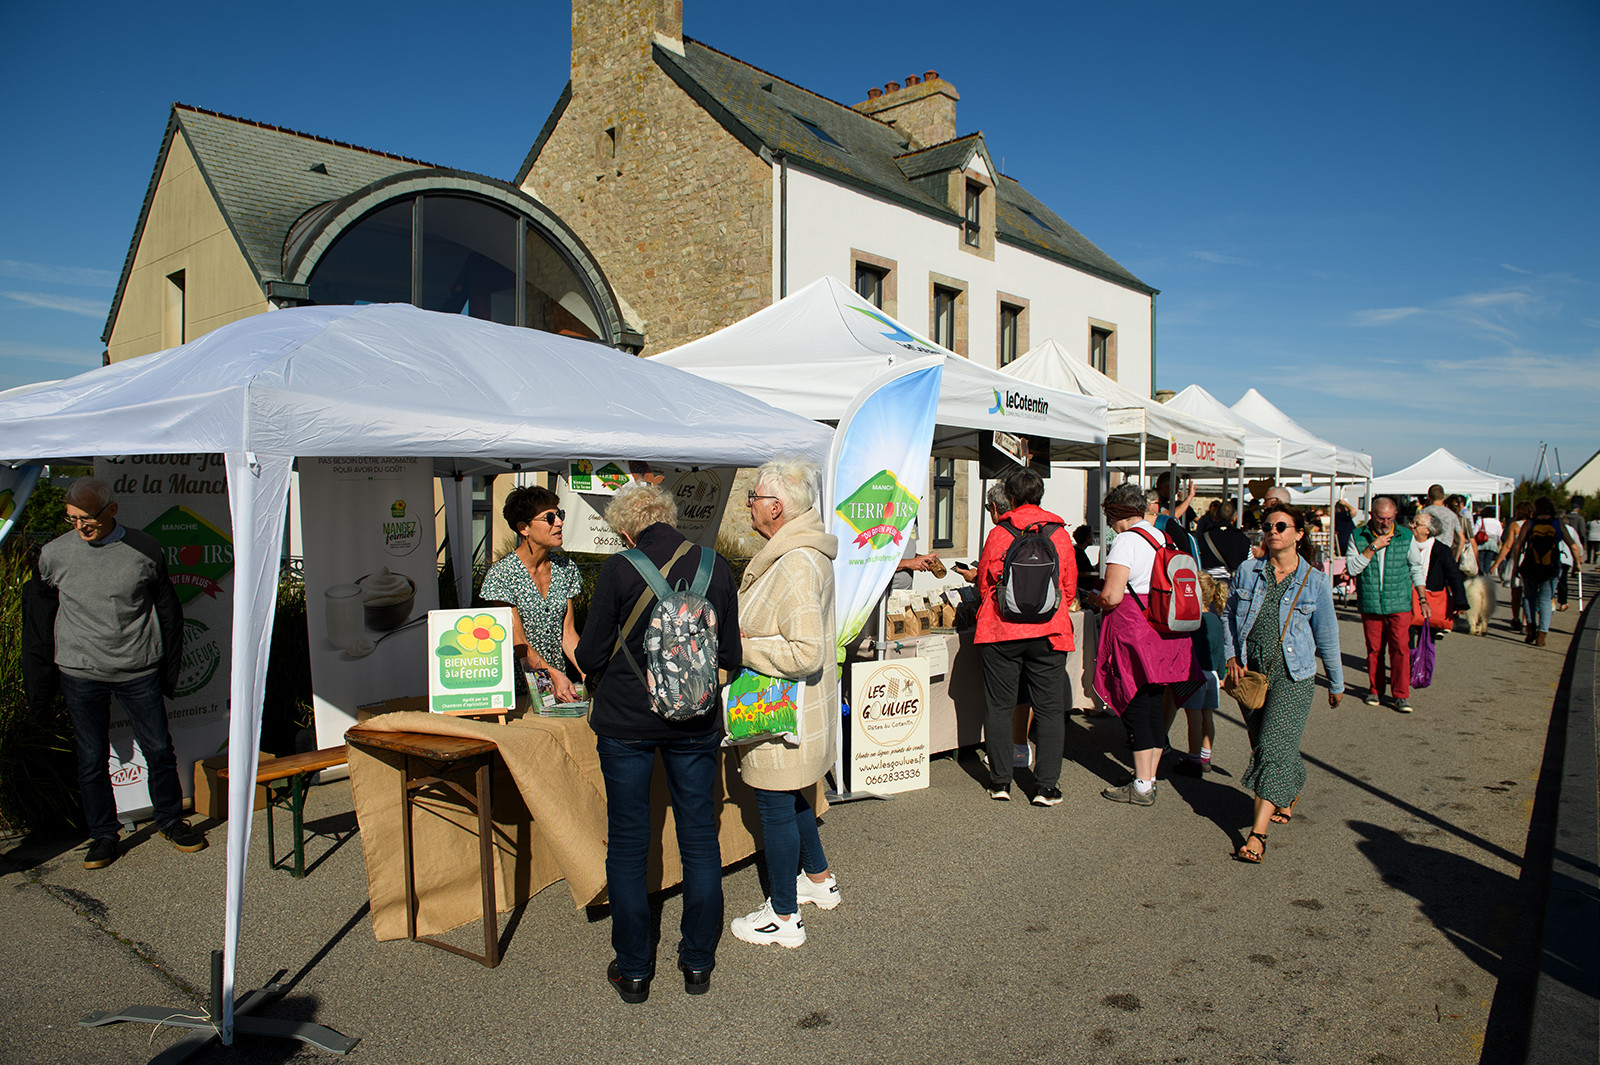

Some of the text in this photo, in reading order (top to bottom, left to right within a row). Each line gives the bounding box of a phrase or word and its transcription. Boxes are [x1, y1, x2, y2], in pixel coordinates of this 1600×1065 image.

[1005, 390, 1049, 415] leCotentin
[384, 465, 403, 473] GOÛT
[113, 474, 138, 494] de
[142, 474, 162, 494] la
[676, 484, 696, 498] LES
[161, 523, 199, 531] MANCHE
[383, 521, 417, 535] MANGEZ
[444, 656, 499, 668] BIENVENUE
[451, 669, 459, 677] la
[460, 667, 499, 679] ferme
[868, 684, 886, 699] LES
[865, 768, 921, 785] 0662833336
